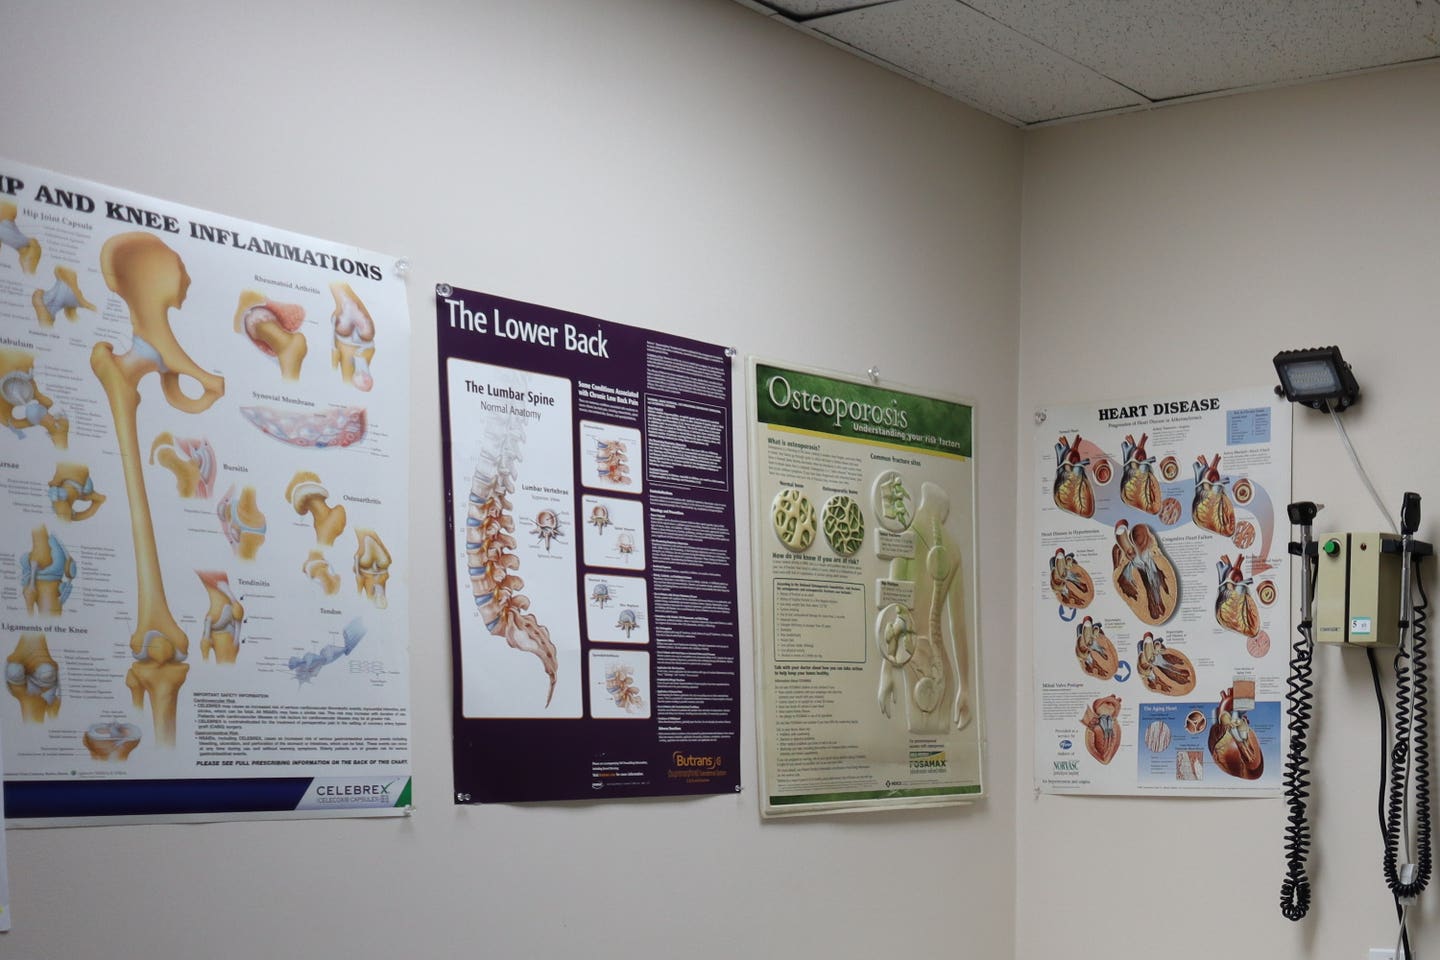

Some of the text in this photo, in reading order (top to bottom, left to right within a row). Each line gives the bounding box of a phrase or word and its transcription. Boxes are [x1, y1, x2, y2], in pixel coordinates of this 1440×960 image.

[62, 215, 93, 231] Capsule
[34, 185, 96, 214] AND
[105, 201, 180, 234] KNEE
[188, 221, 383, 282] INFLAMMATIONS
[445, 299, 610, 358] The Lower Back
[464, 380, 555, 407] The Lumbar Spine
[768, 375, 909, 429] Osteoporosis
[480, 401, 542, 420] Normal Anatomy
[1098, 398, 1220, 422] HEART DISEASE
[852, 423, 906, 441] Understanding
[906, 431, 924, 444] your
[768, 437, 780, 446] What
[223, 463, 249, 473] Bursitis
[521, 483, 542, 493] Lumbar
[238, 577, 271, 588] Tendinitis
[319, 607, 342, 616] Tendon
[1, 622, 89, 635] Ligaments of the Knee
[676, 754, 713, 768] Butrans
[316, 784, 391, 796] CELEBREX
